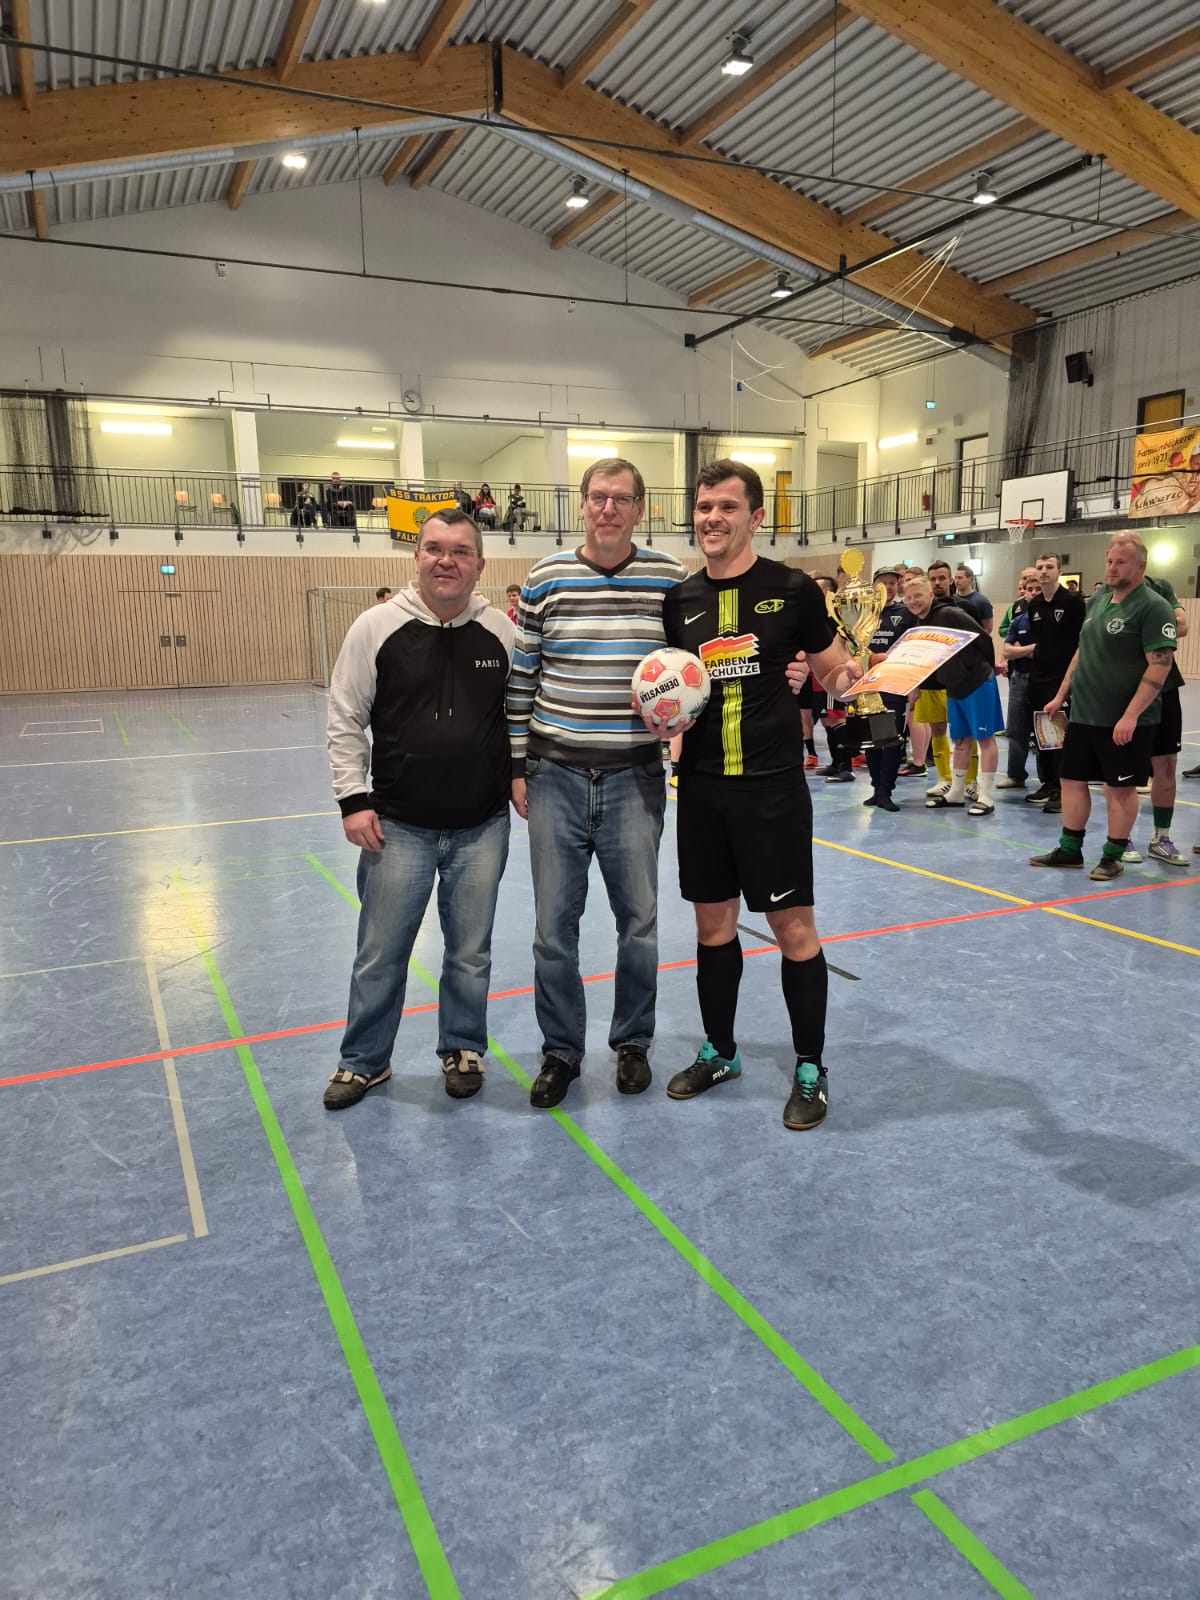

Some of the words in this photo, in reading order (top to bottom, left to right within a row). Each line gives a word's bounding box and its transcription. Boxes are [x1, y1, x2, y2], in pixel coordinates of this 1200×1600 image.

[390, 489, 410, 499] BSG
[413, 492, 455, 501] TRAKTOR
[474, 659, 500, 668] PARIS
[704, 656, 747, 669] FARBEN
[640, 678, 679, 703] DERBYSTAR
[712, 1065, 730, 1081] FILA
